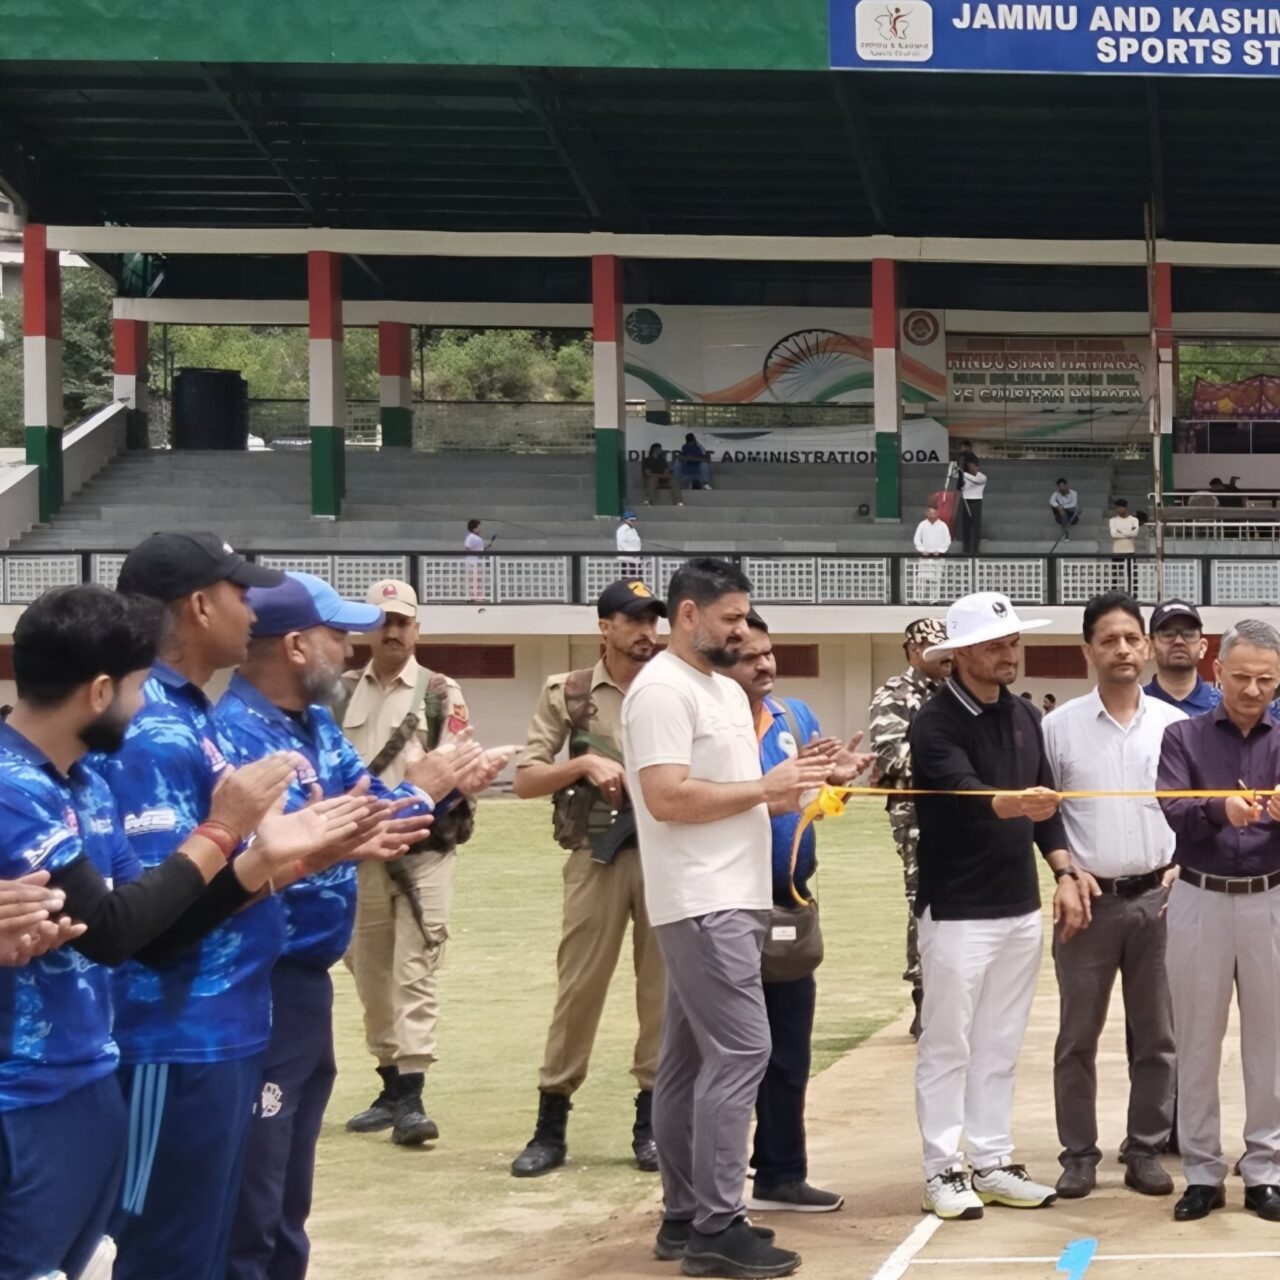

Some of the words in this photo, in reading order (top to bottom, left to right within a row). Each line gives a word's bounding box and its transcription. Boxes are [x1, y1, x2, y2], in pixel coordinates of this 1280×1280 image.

[952, 3, 1078, 30] JAMMU
[1089, 6, 1161, 32] AND
[1096, 37, 1232, 64] SPORTS
[903, 449, 940, 463] ODA
